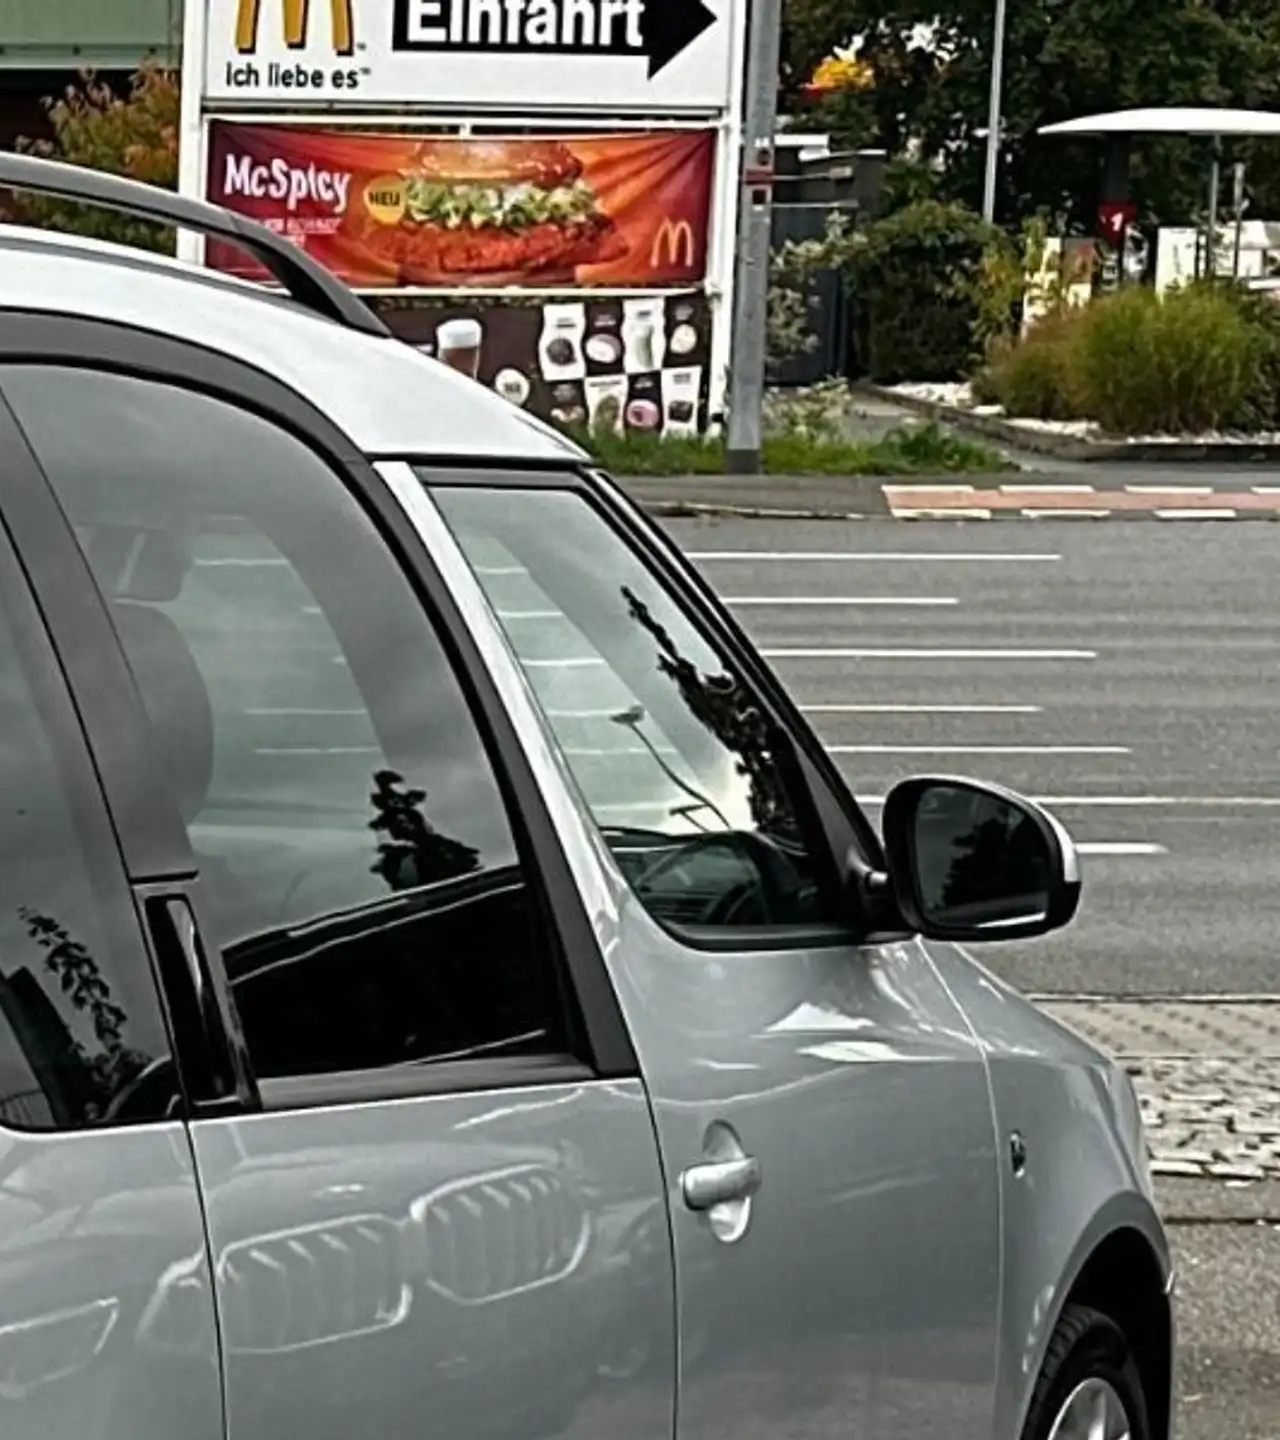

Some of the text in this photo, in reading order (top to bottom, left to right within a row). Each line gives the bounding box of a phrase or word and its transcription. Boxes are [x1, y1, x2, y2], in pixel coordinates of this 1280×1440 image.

[407, 0, 643, 46] Einfahrt
[226, 63, 259, 88] Ich
[268, 63, 323, 88] liebe
[224, 153, 352, 214] McSpicy
